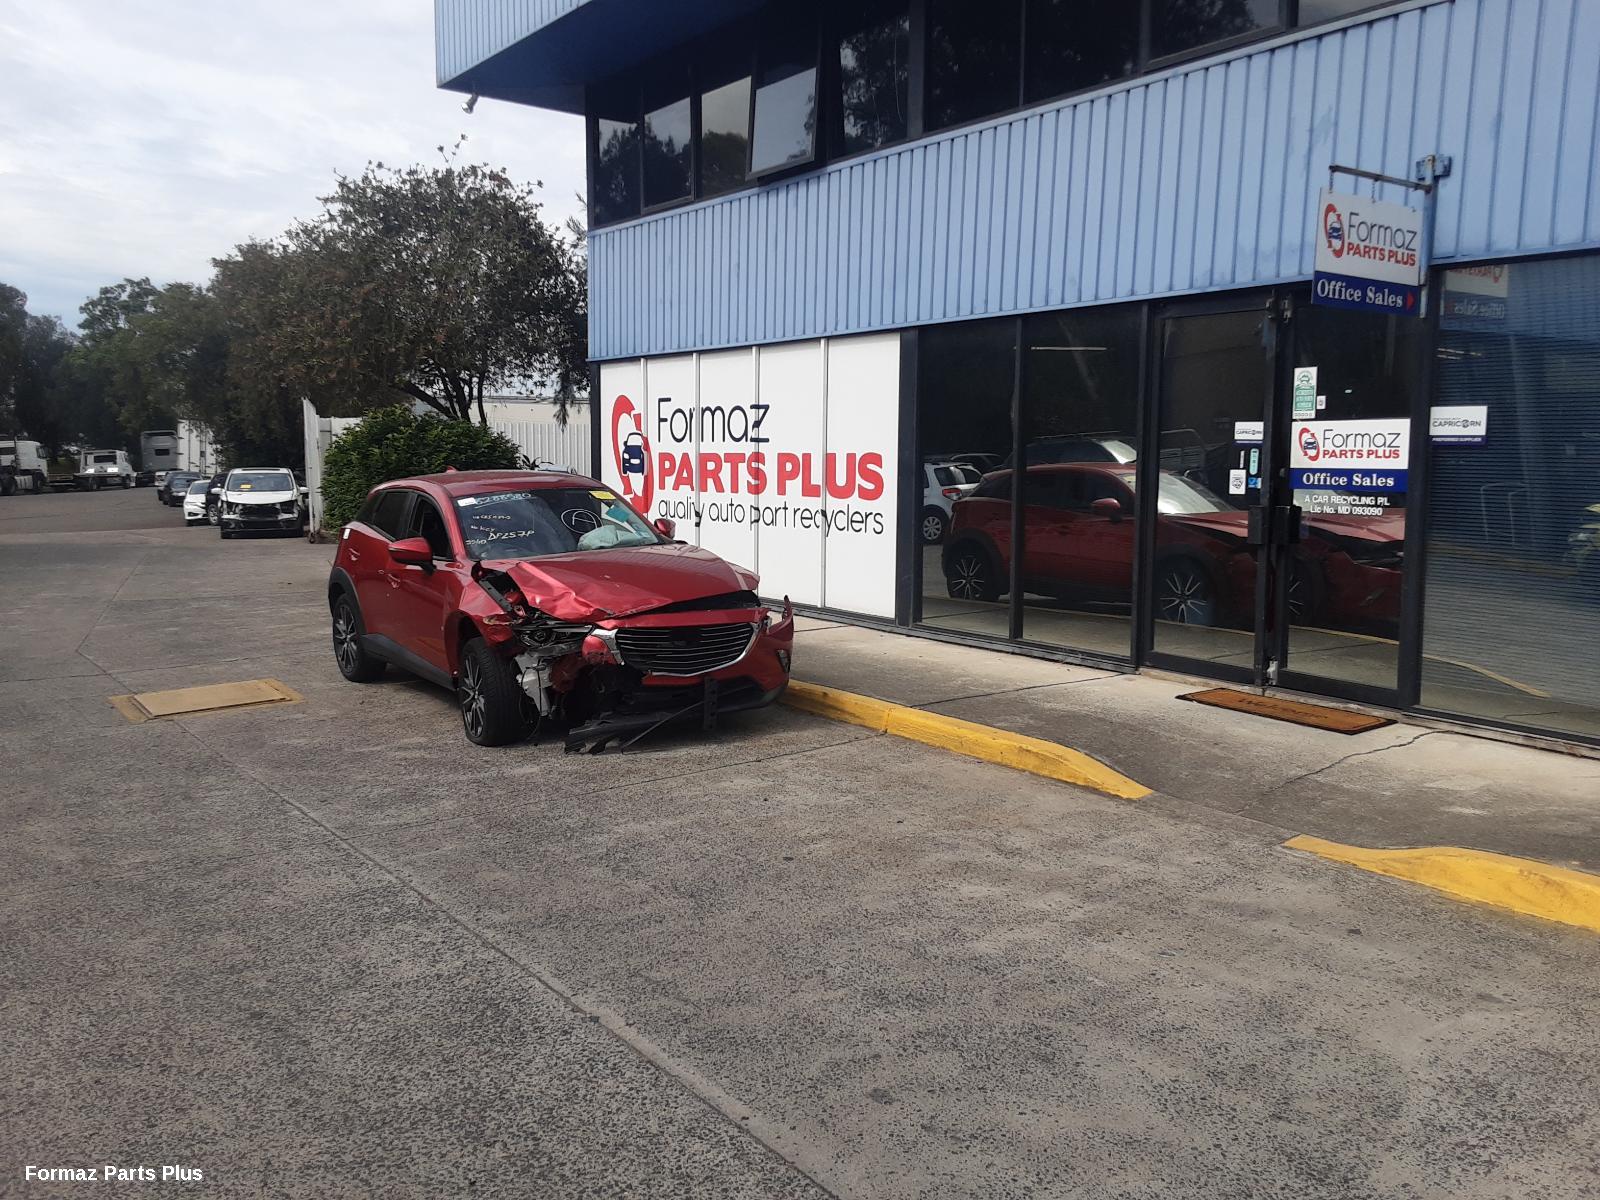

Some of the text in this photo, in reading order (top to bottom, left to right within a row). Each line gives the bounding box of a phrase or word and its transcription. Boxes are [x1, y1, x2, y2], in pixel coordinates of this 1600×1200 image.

[1347, 211, 1417, 252] Formaz
[1346, 242, 1416, 267] PARTS PLUS
[1317, 278, 1404, 308] Office Sales
[657, 397, 770, 443] Formaz
[1322, 428, 1401, 449] Formaz
[1322, 449, 1400, 459] PARTS PLUS
[658, 451, 884, 501] PARTS PLUS
[1302, 471, 1394, 487] Office Sales
[1304, 494, 1311, 503] A
[1312, 495, 1329, 504] CAR
[1330, 495, 1375, 505] RECYCLING
[1310, 505, 1321, 513] Lic
[1338, 506, 1351, 514] MD
[709, 499, 746, 524] auto
[750, 501, 789, 531] part
[793, 504, 884, 538] recyclers
